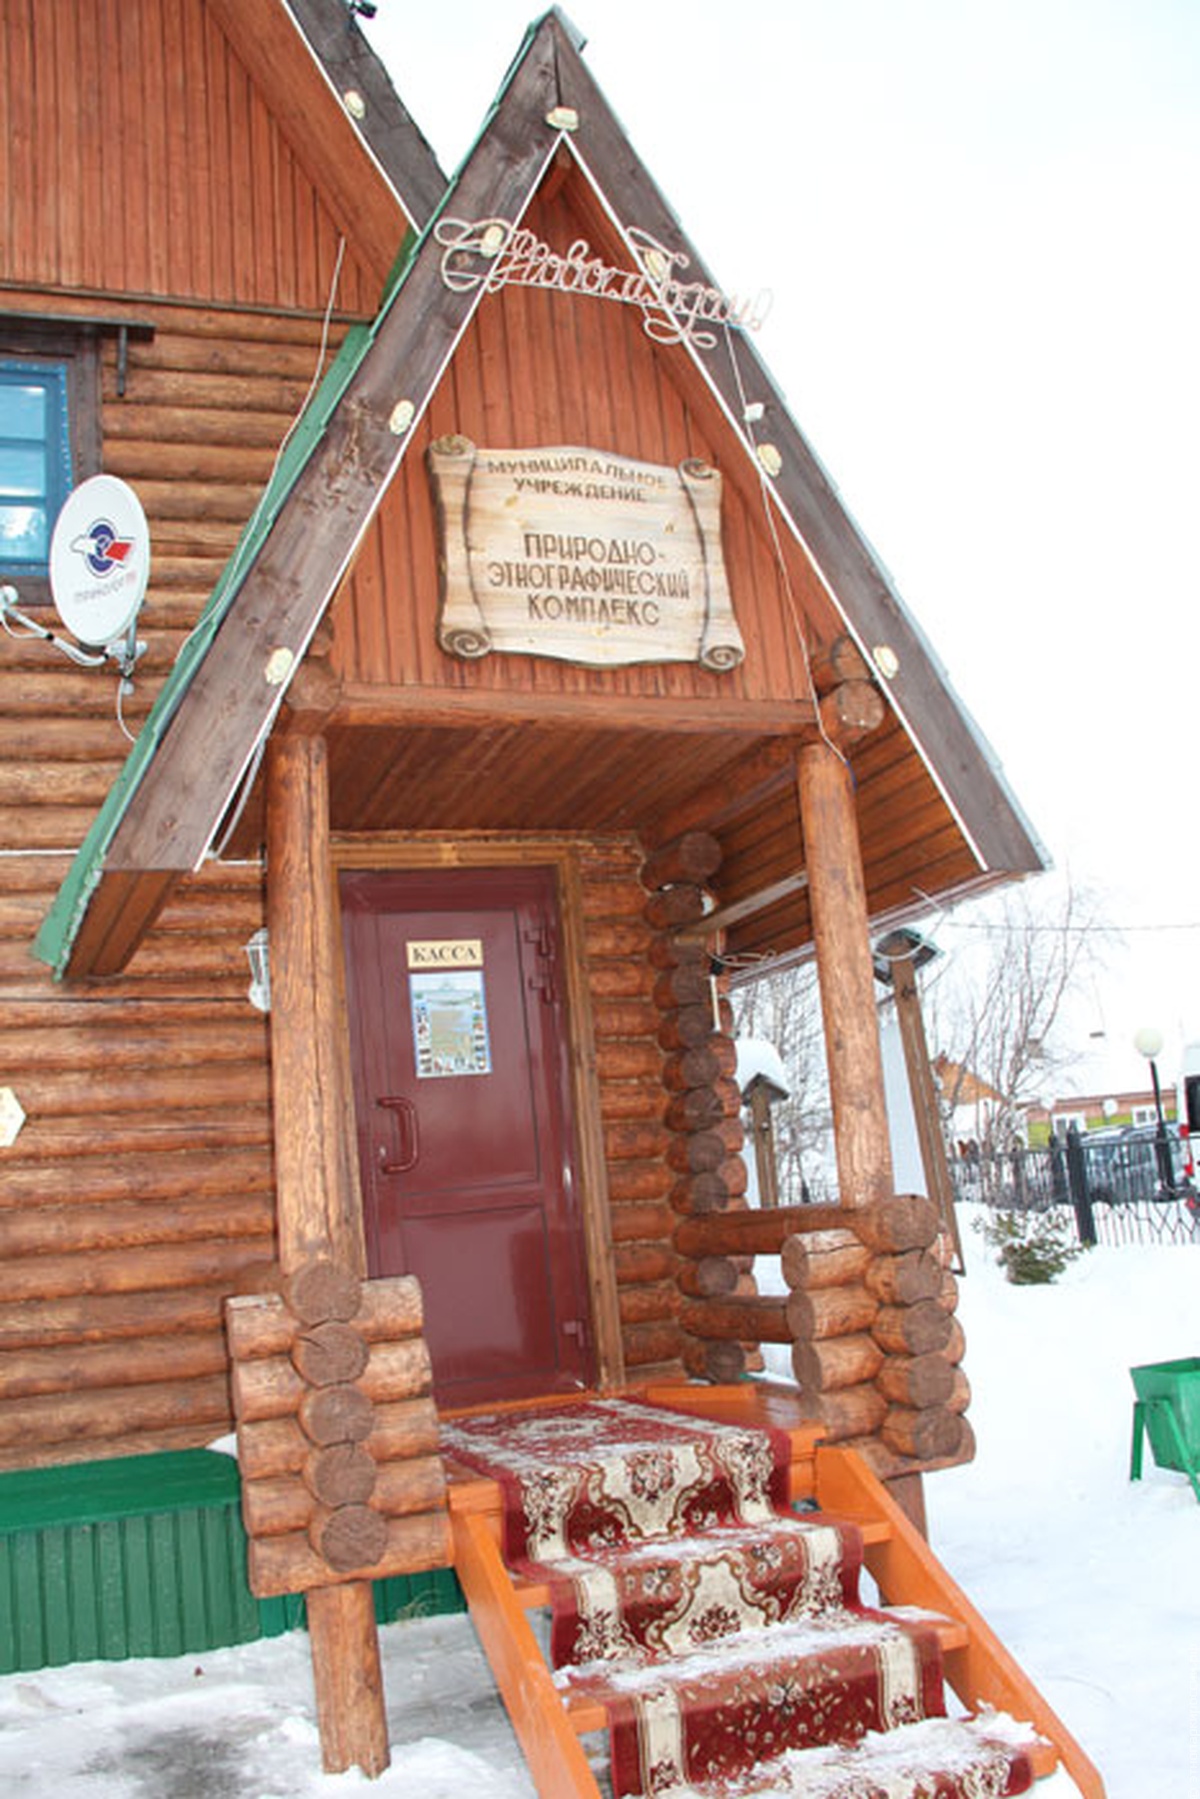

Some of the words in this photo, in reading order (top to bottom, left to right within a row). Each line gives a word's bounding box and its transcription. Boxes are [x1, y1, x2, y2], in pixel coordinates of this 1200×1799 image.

[486, 457, 667, 489] МУНИЦИПАЛЬНОЕ
[513, 477, 648, 502] УЧРЕЖДЕНИЕ
[524, 533, 666, 562] ПРИРОДНО-
[487, 561, 690, 600] ЭТНОГРАФИЧЕСКИЙ
[527, 594, 660, 626] КОМПЛЕКС
[412, 946, 478, 963] КАССА
